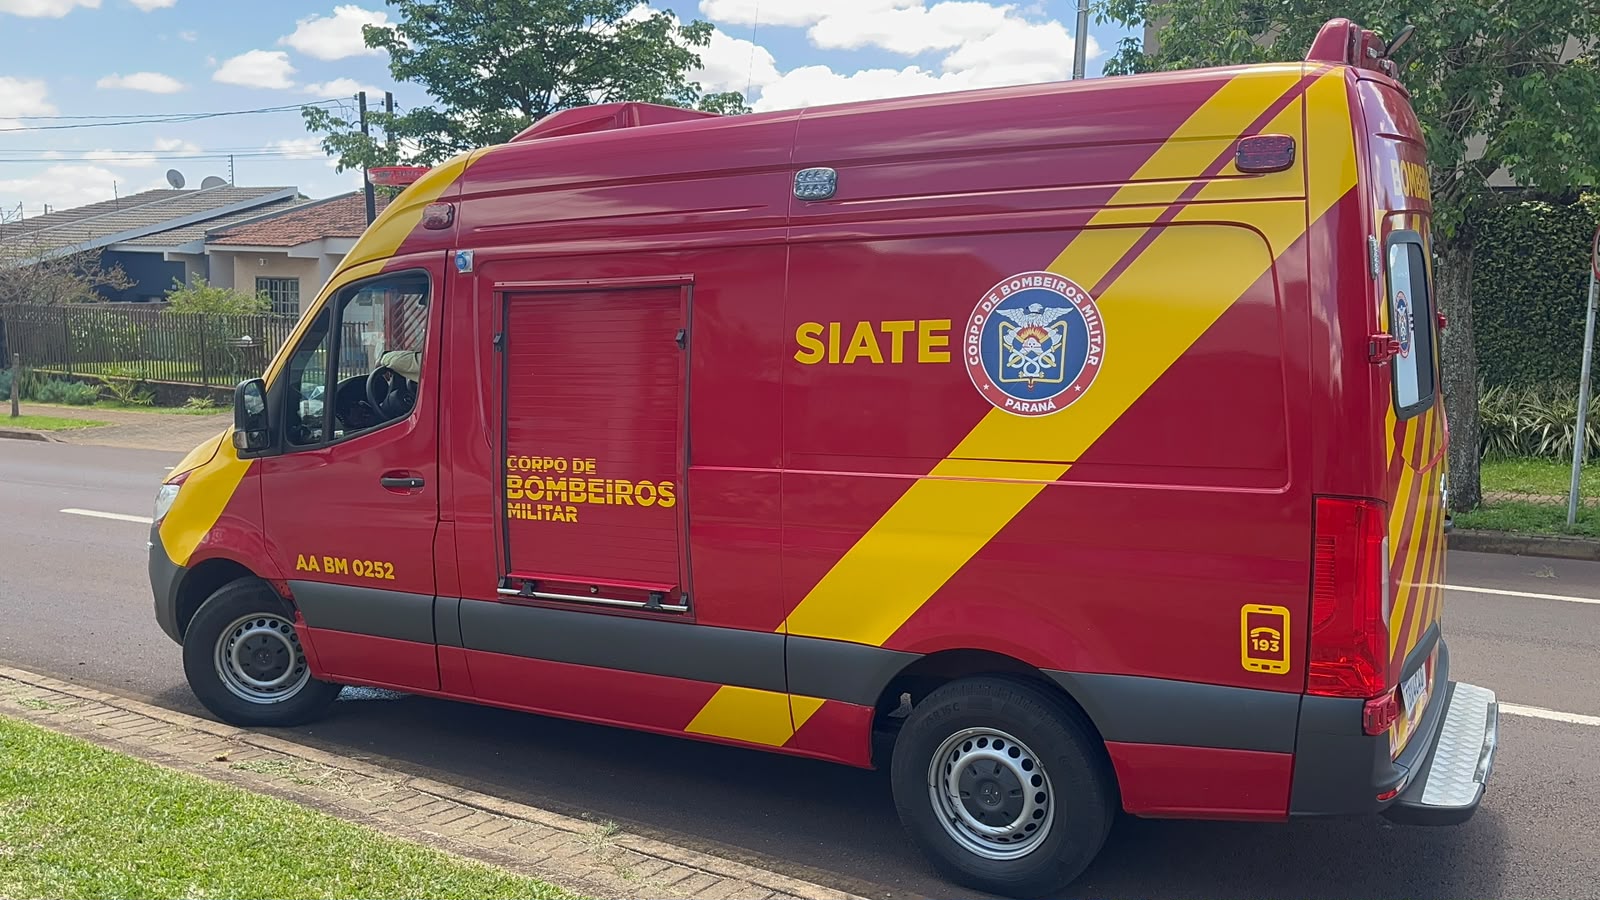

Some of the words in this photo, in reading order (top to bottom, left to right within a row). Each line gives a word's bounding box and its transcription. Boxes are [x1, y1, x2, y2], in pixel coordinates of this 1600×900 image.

[968, 314, 984, 366] CORPO
[982, 293, 999, 312] DE
[1000, 276, 1084, 304] BOMBEIROS
[1081, 304, 1102, 366] MILITAR
[793, 319, 952, 365] SIATE
[1004, 397, 1057, 413] PARANÁ
[506, 455, 568, 474] CORPO
[572, 457, 597, 475] DE
[506, 474, 676, 508] BOMBEIROS
[507, 502, 578, 523] MILITAR
[296, 554, 321, 572] AA
[323, 556, 349, 575] BM
[352, 559, 395, 580] 0252
[1251, 638, 1280, 652] 193
